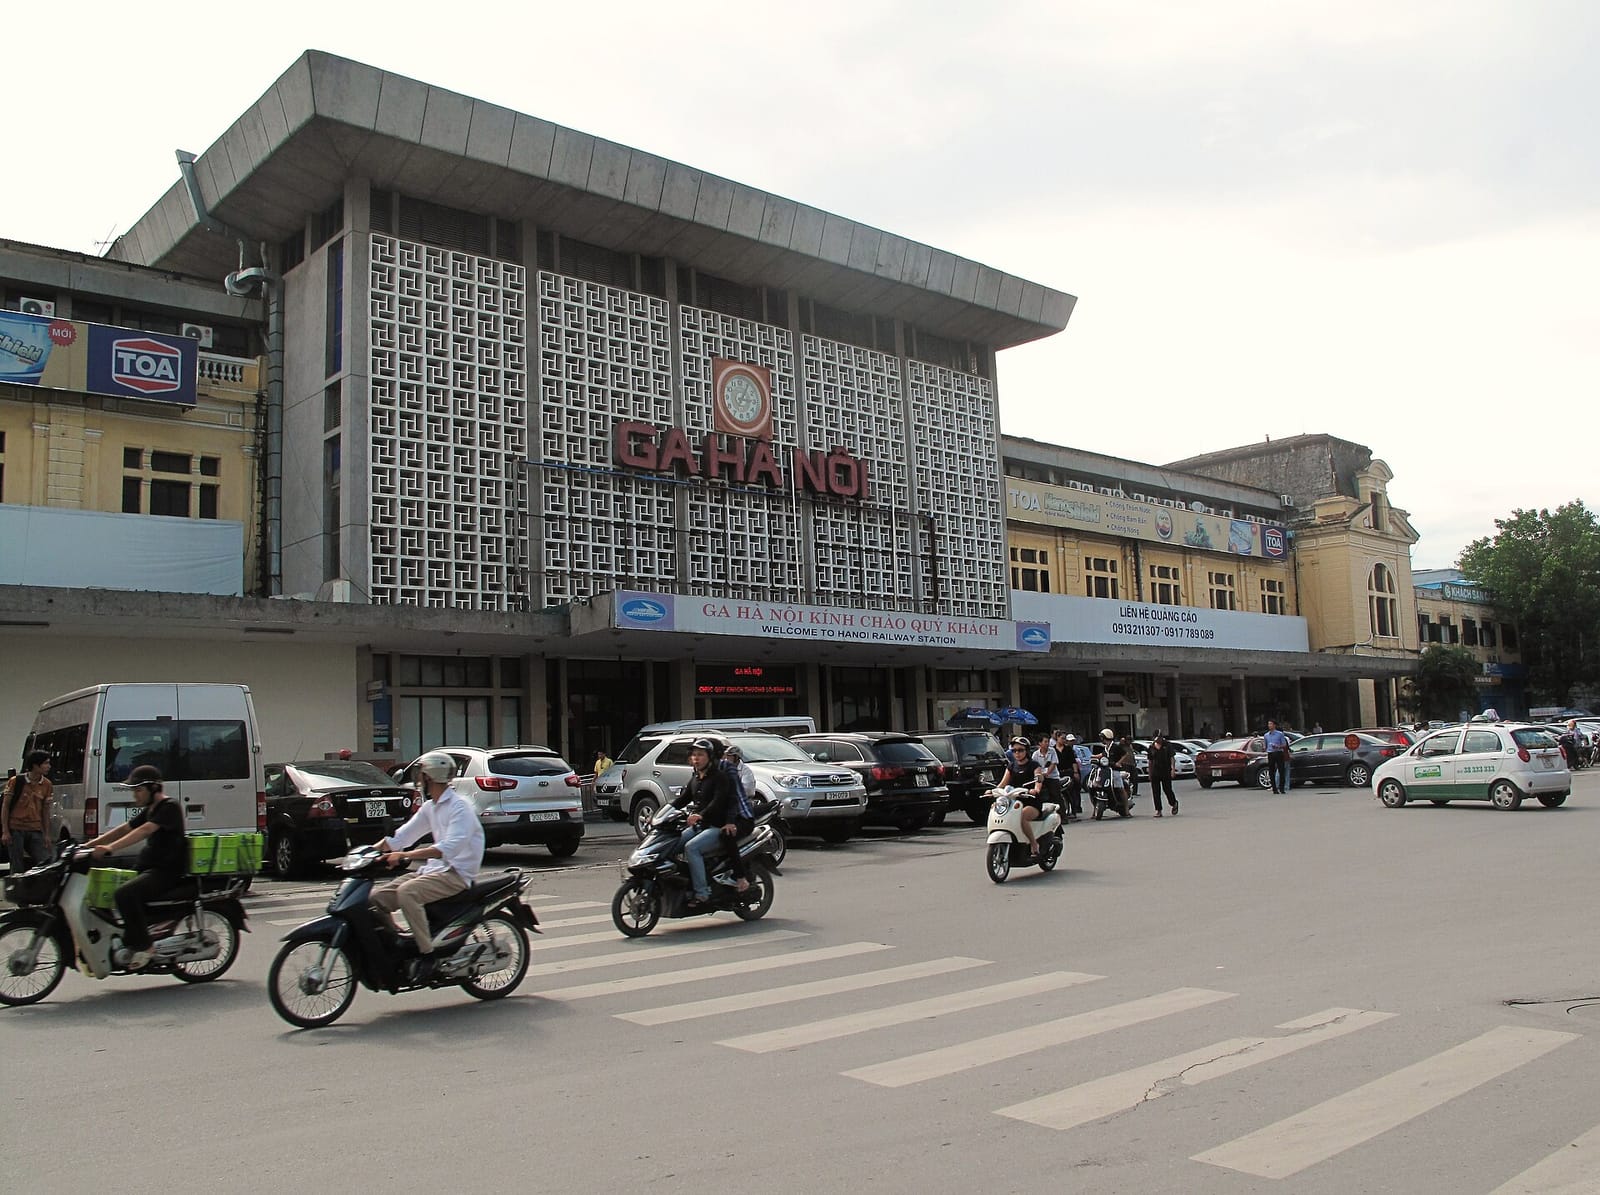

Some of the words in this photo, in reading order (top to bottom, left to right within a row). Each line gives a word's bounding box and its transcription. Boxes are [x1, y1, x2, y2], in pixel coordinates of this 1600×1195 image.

[52, 327, 72, 339] MỚI
[117, 351, 176, 380] TOA
[614, 421, 699, 475] GA
[703, 433, 783, 488] HÀ
[1009, 488, 1041, 512] TOA
[1267, 536, 1281, 548] TOA
[703, 603, 730, 618] GA
[737, 604, 764, 620] HÀ
[770, 606, 803, 626] NỘI
[810, 609, 855, 626] KÍNH
[860, 614, 906, 630] CHÀO
[911, 618, 943, 633] QUÝ
[948, 620, 999, 636] KHÁCH
[1120, 605, 1137, 618] LIÊN
[1181, 610, 1197, 623] CÁO
[761, 625, 818, 637] WELCOME
[821, 629, 835, 637] TO
[838, 630, 869, 640] HANOI
[872, 632, 916, 642] RAILWAY
[918, 636, 956, 644] STATION
